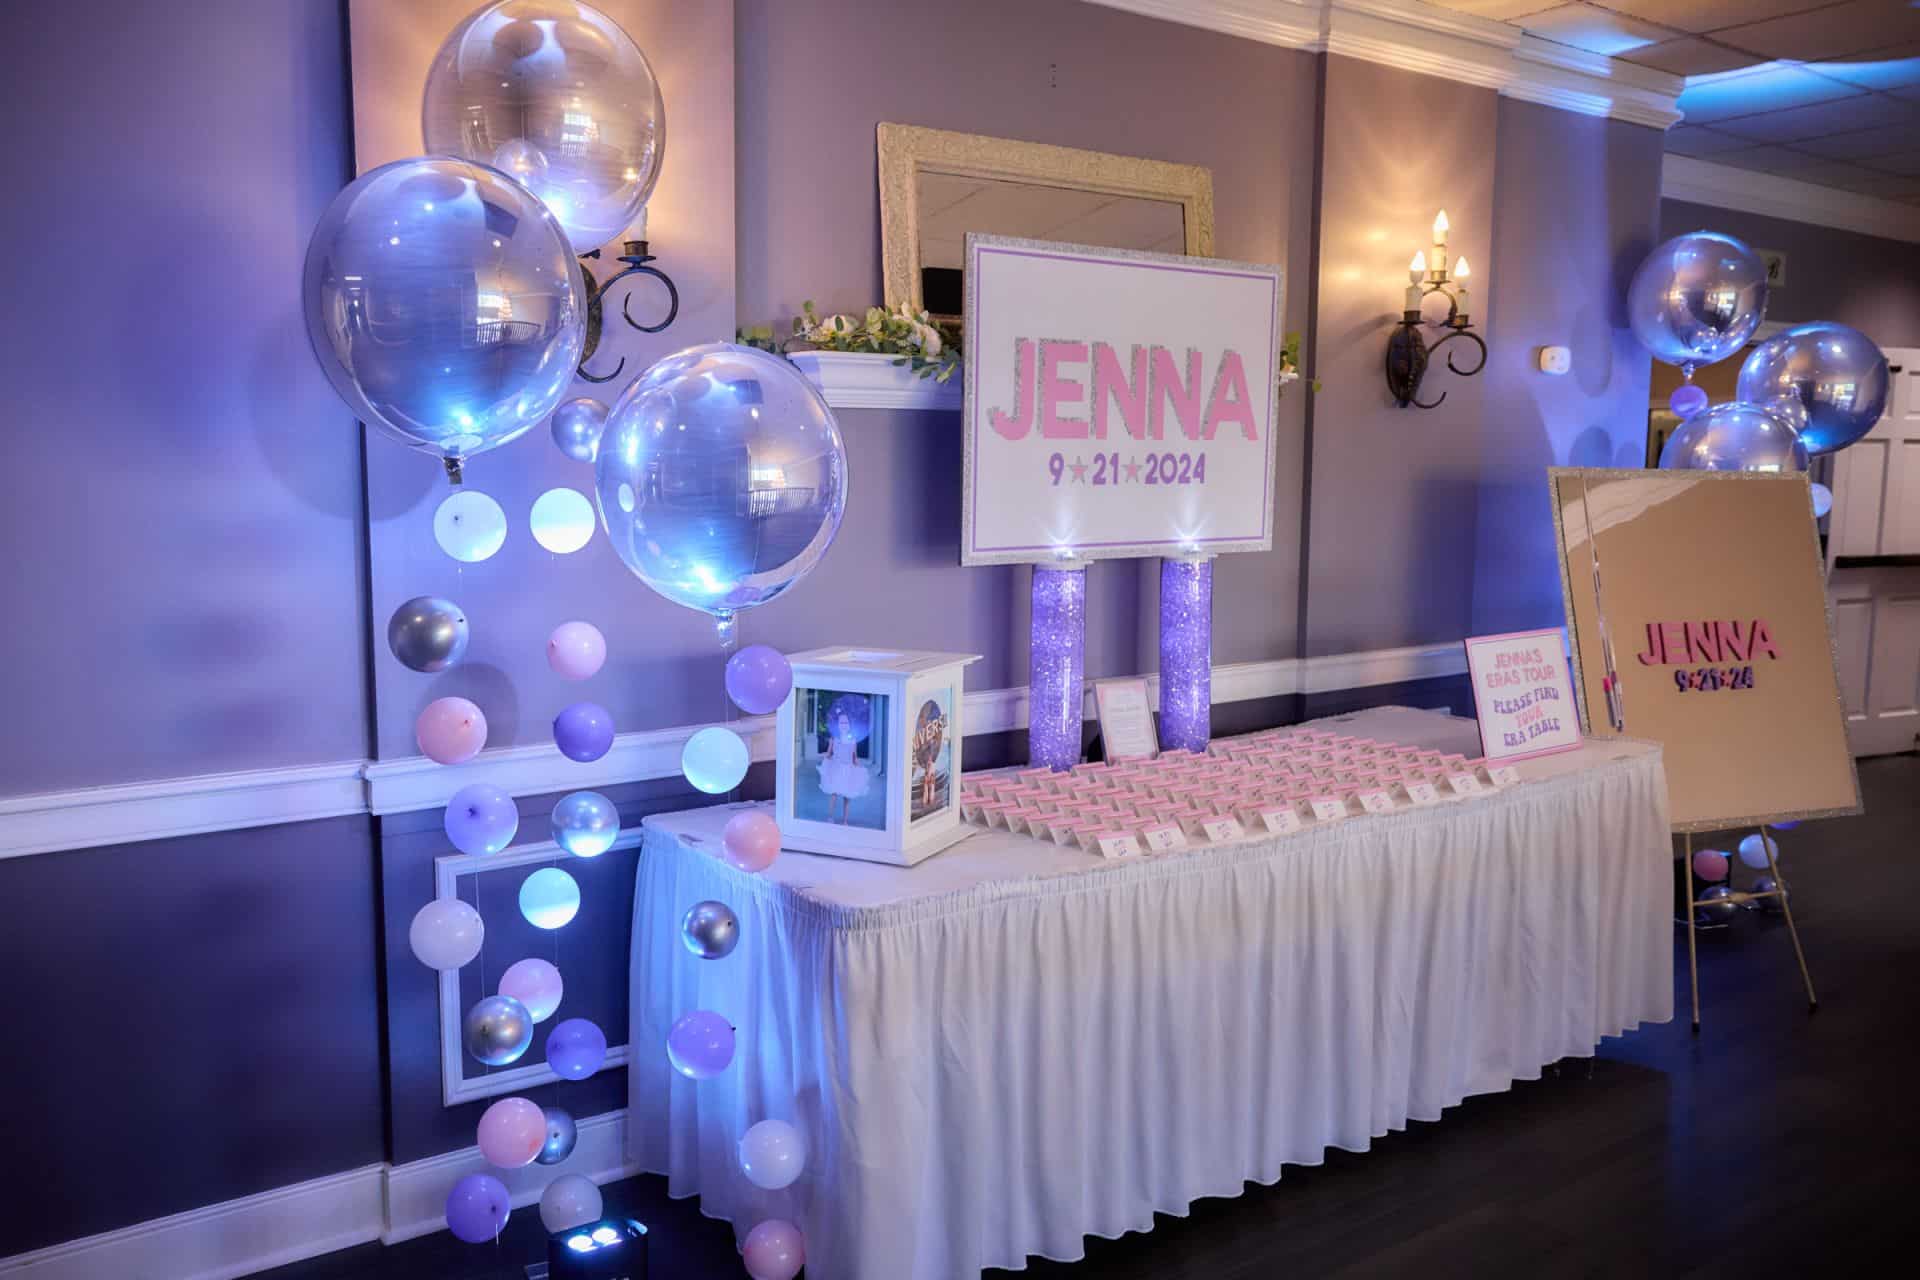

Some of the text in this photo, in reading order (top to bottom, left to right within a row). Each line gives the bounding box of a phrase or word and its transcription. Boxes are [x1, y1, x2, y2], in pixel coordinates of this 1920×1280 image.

[986, 337, 1259, 441] JENNA
[1637, 620, 1782, 666] JENNA
[1485, 665, 1555, 688] ERAS TOUR
[1494, 686, 1560, 714] PLEASE FIND
[1504, 718, 1561, 747] ERA TABLE
